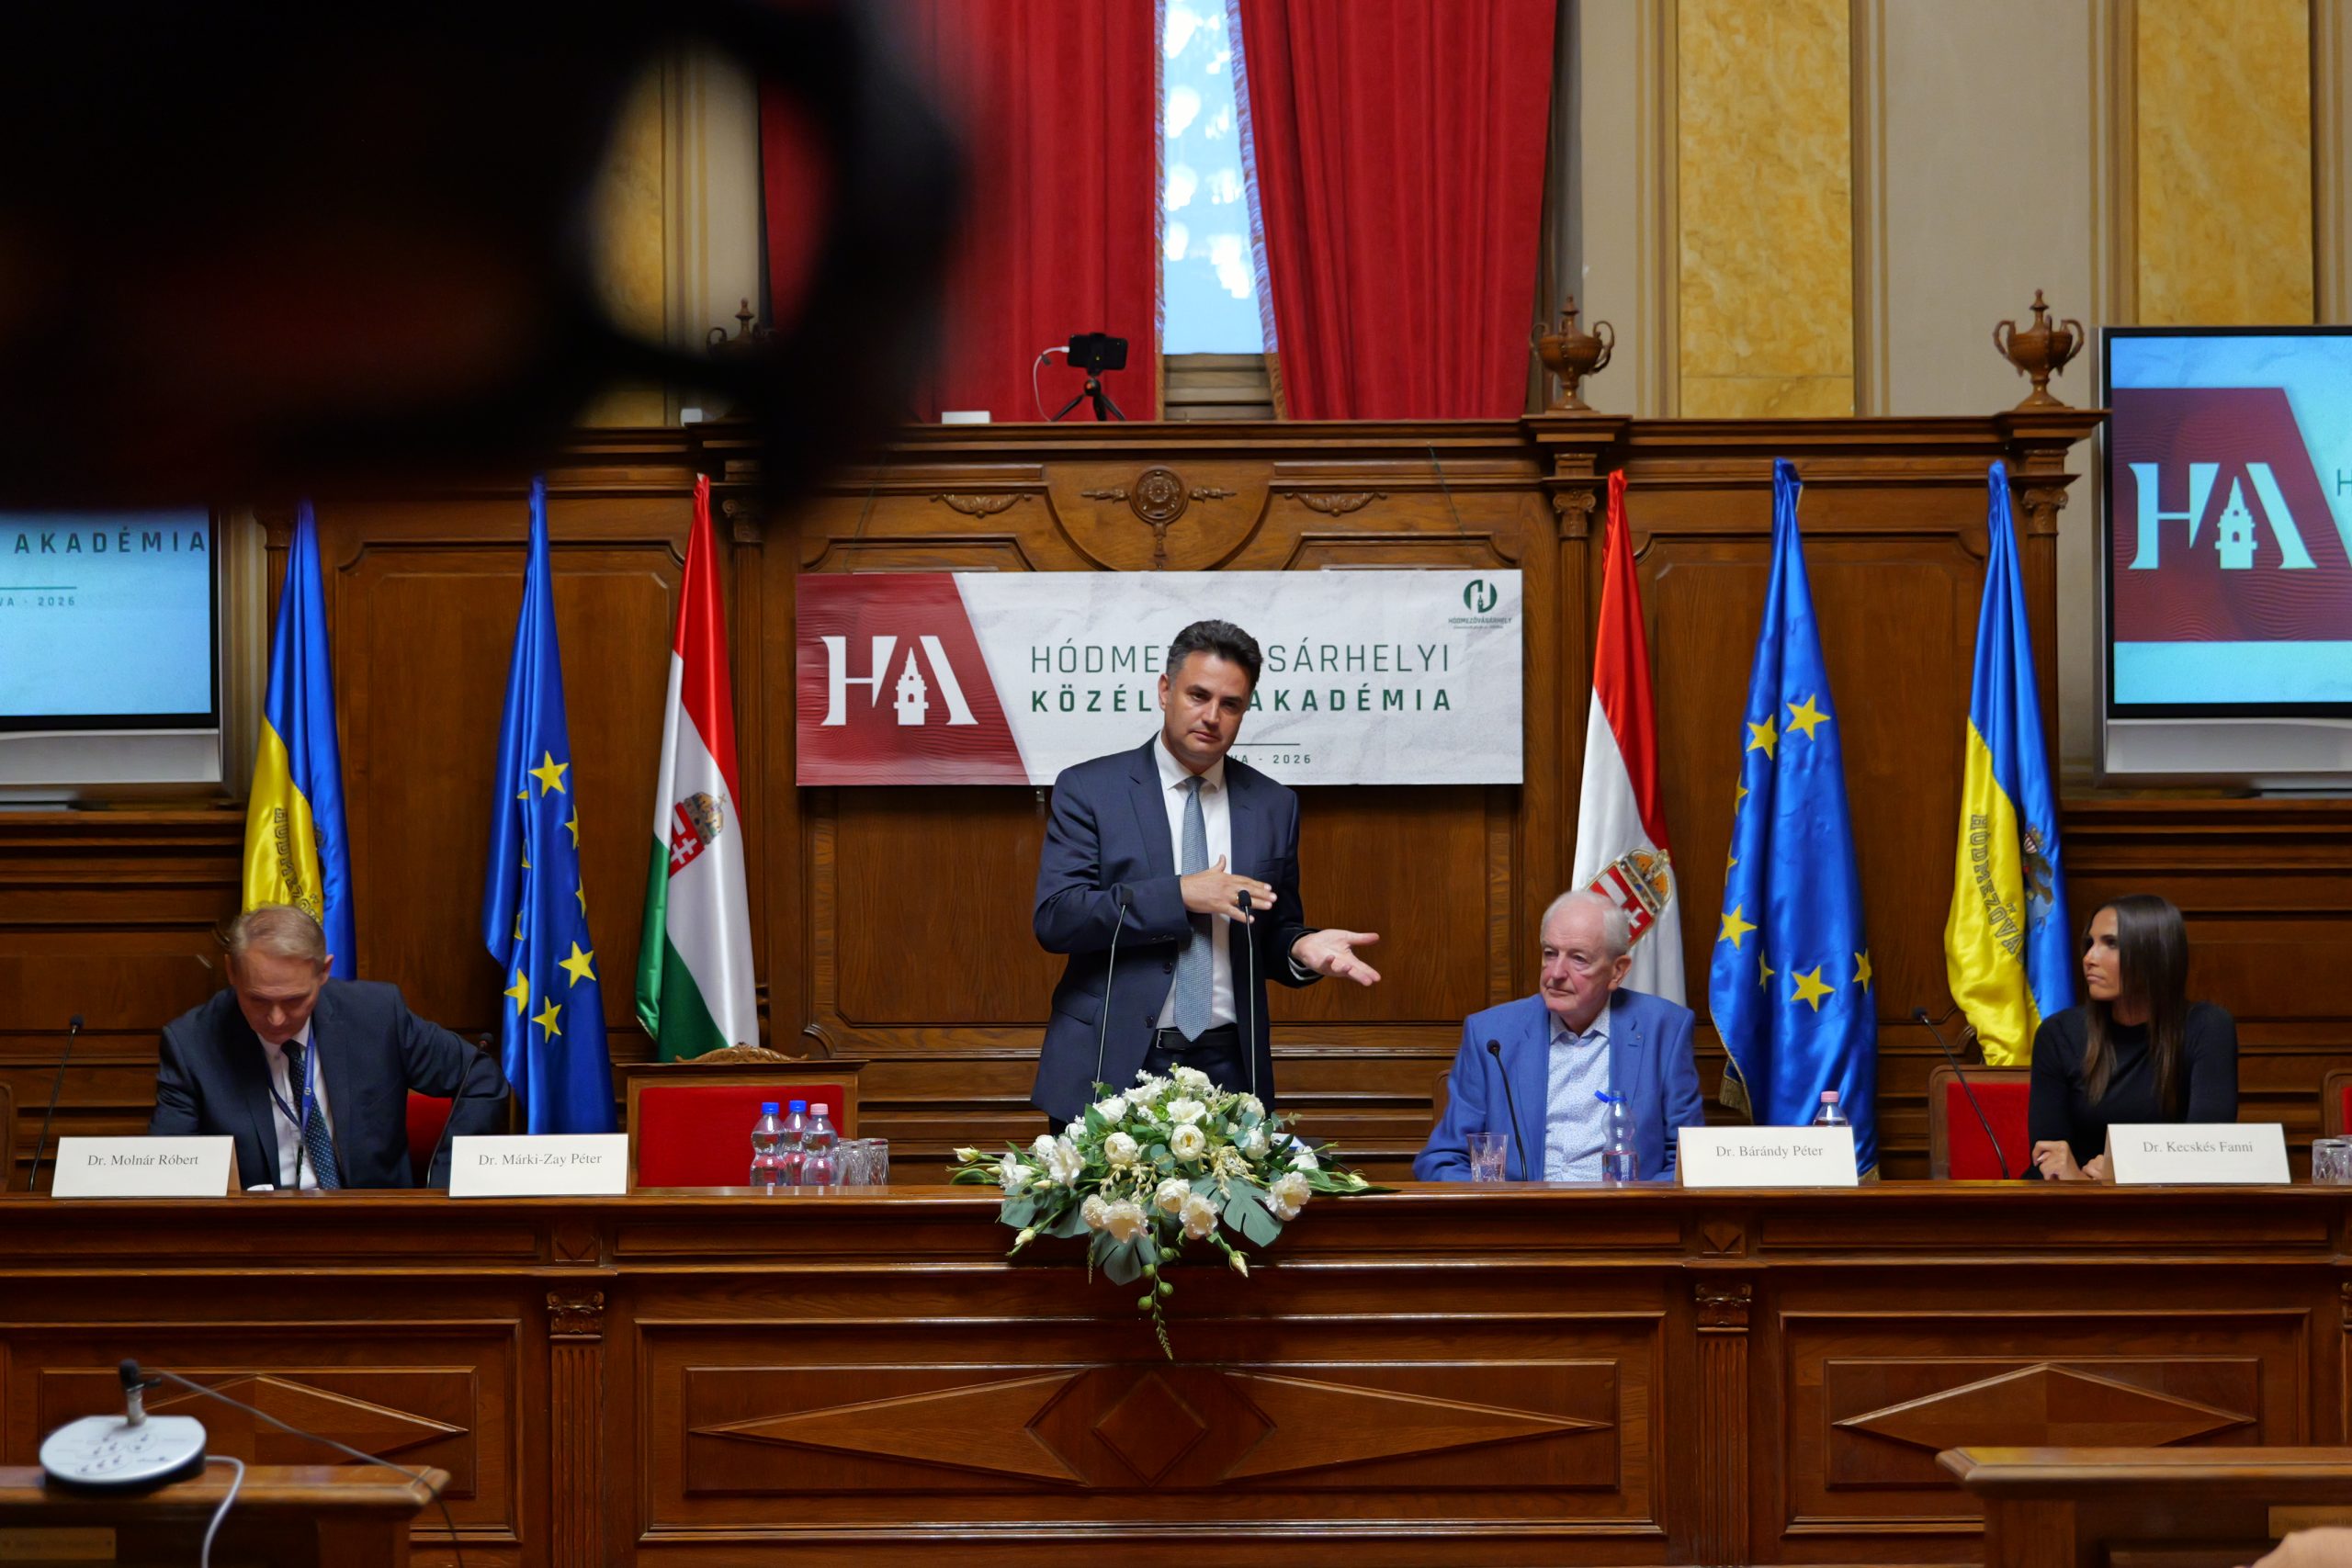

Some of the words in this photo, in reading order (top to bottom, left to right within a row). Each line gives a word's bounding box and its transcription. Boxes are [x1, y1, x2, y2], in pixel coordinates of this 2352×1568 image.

[15, 526, 205, 554] AKADÉMIA
[38, 596, 75, 606] 2026
[1032, 637, 1448, 672] HÓDMESÁRHELYI
[1032, 684, 1152, 712] KÖZÉL
[1247, 682, 1451, 712] AKADÉMIA
[1273, 754, 1311, 764] 2026
[1716, 1145, 1736, 1156] Dr.
[1739, 1145, 1789, 1159] Bárándy
[1792, 1145, 1824, 1156] Péter
[2143, 1142, 2162, 1153] Dr.
[2166, 1141, 2216, 1153] Kecskés
[2220, 1141, 2253, 1152] Fanni
[87, 1155, 107, 1166] Dr.
[111, 1155, 155, 1166] Molnár
[158, 1154, 198, 1165] Róbert
[479, 1155, 498, 1166] Dr.
[502, 1153, 567, 1168] Márki-Zay
[571, 1153, 602, 1164] Péter
